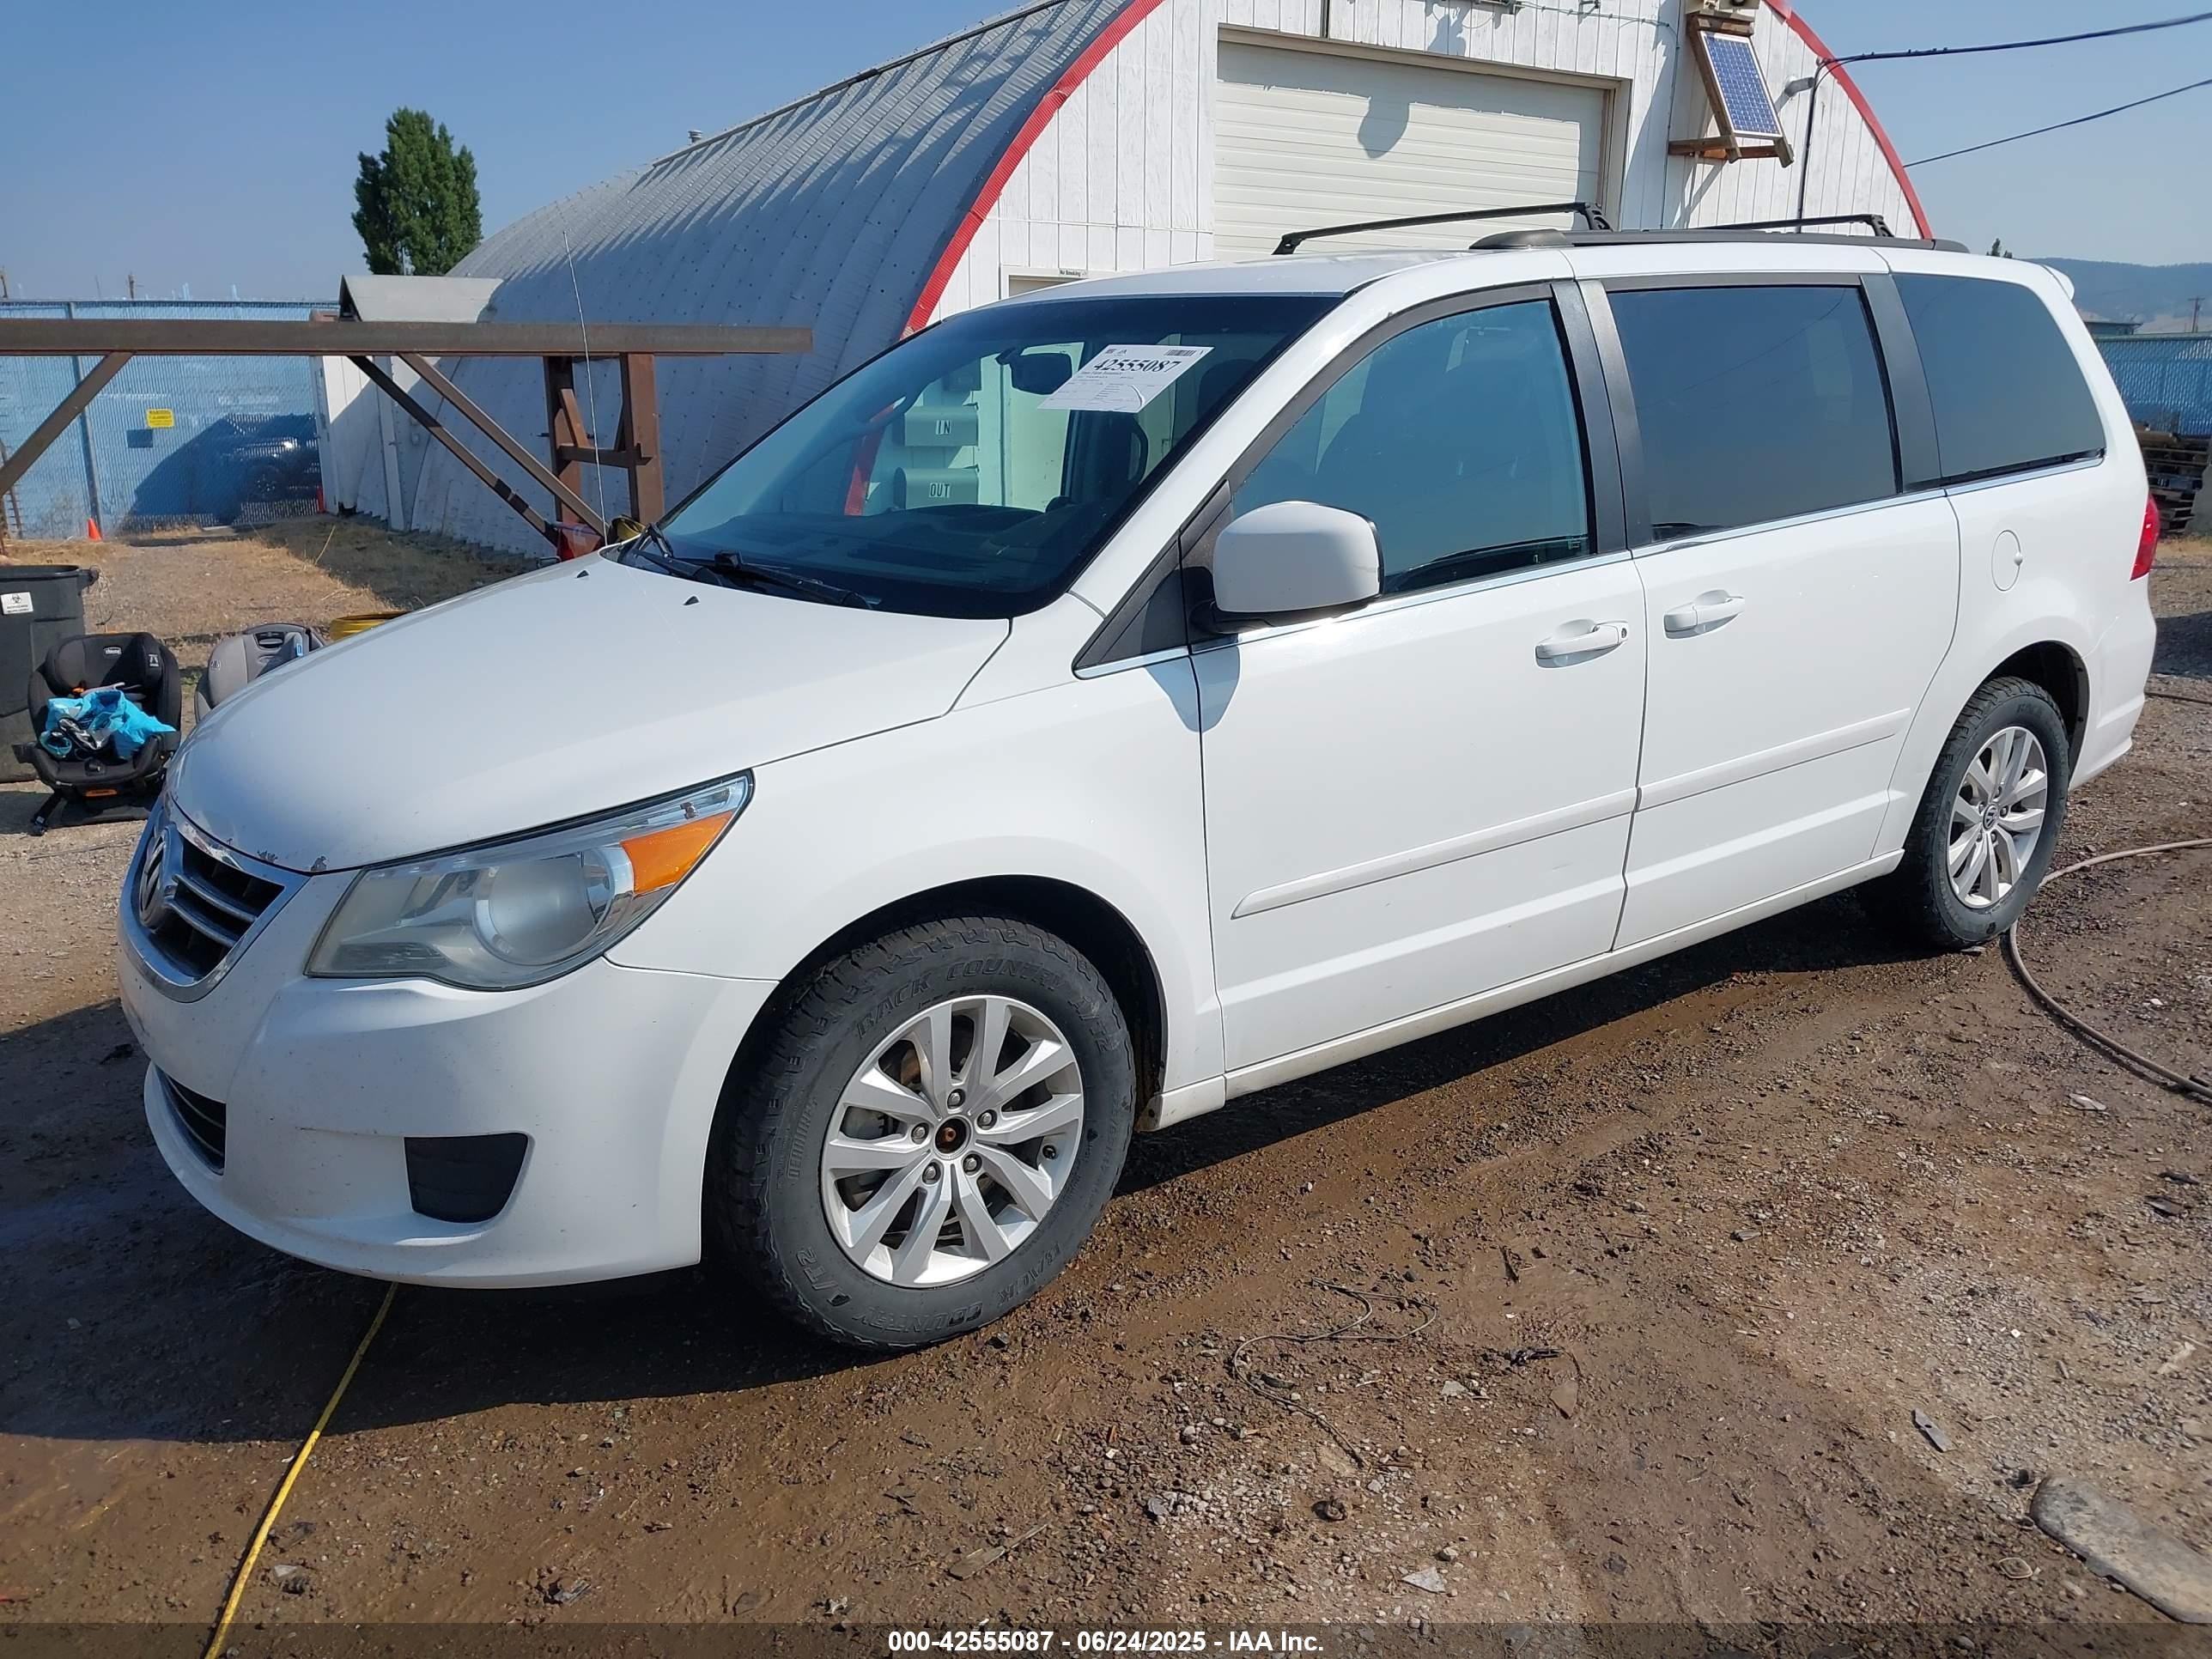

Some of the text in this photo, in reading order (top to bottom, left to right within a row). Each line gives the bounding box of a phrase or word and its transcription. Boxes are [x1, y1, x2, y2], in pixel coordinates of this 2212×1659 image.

[1094, 359, 1182, 372] 42555087
[937, 419, 951, 434] IN
[930, 483, 951, 497] OUT
[855, 973, 933, 1039] BACK
[946, 959, 1066, 990] COUNTRY
[796, 1247, 852, 1307] A/T2
[851, 1301, 983, 1333] COUNTRY
